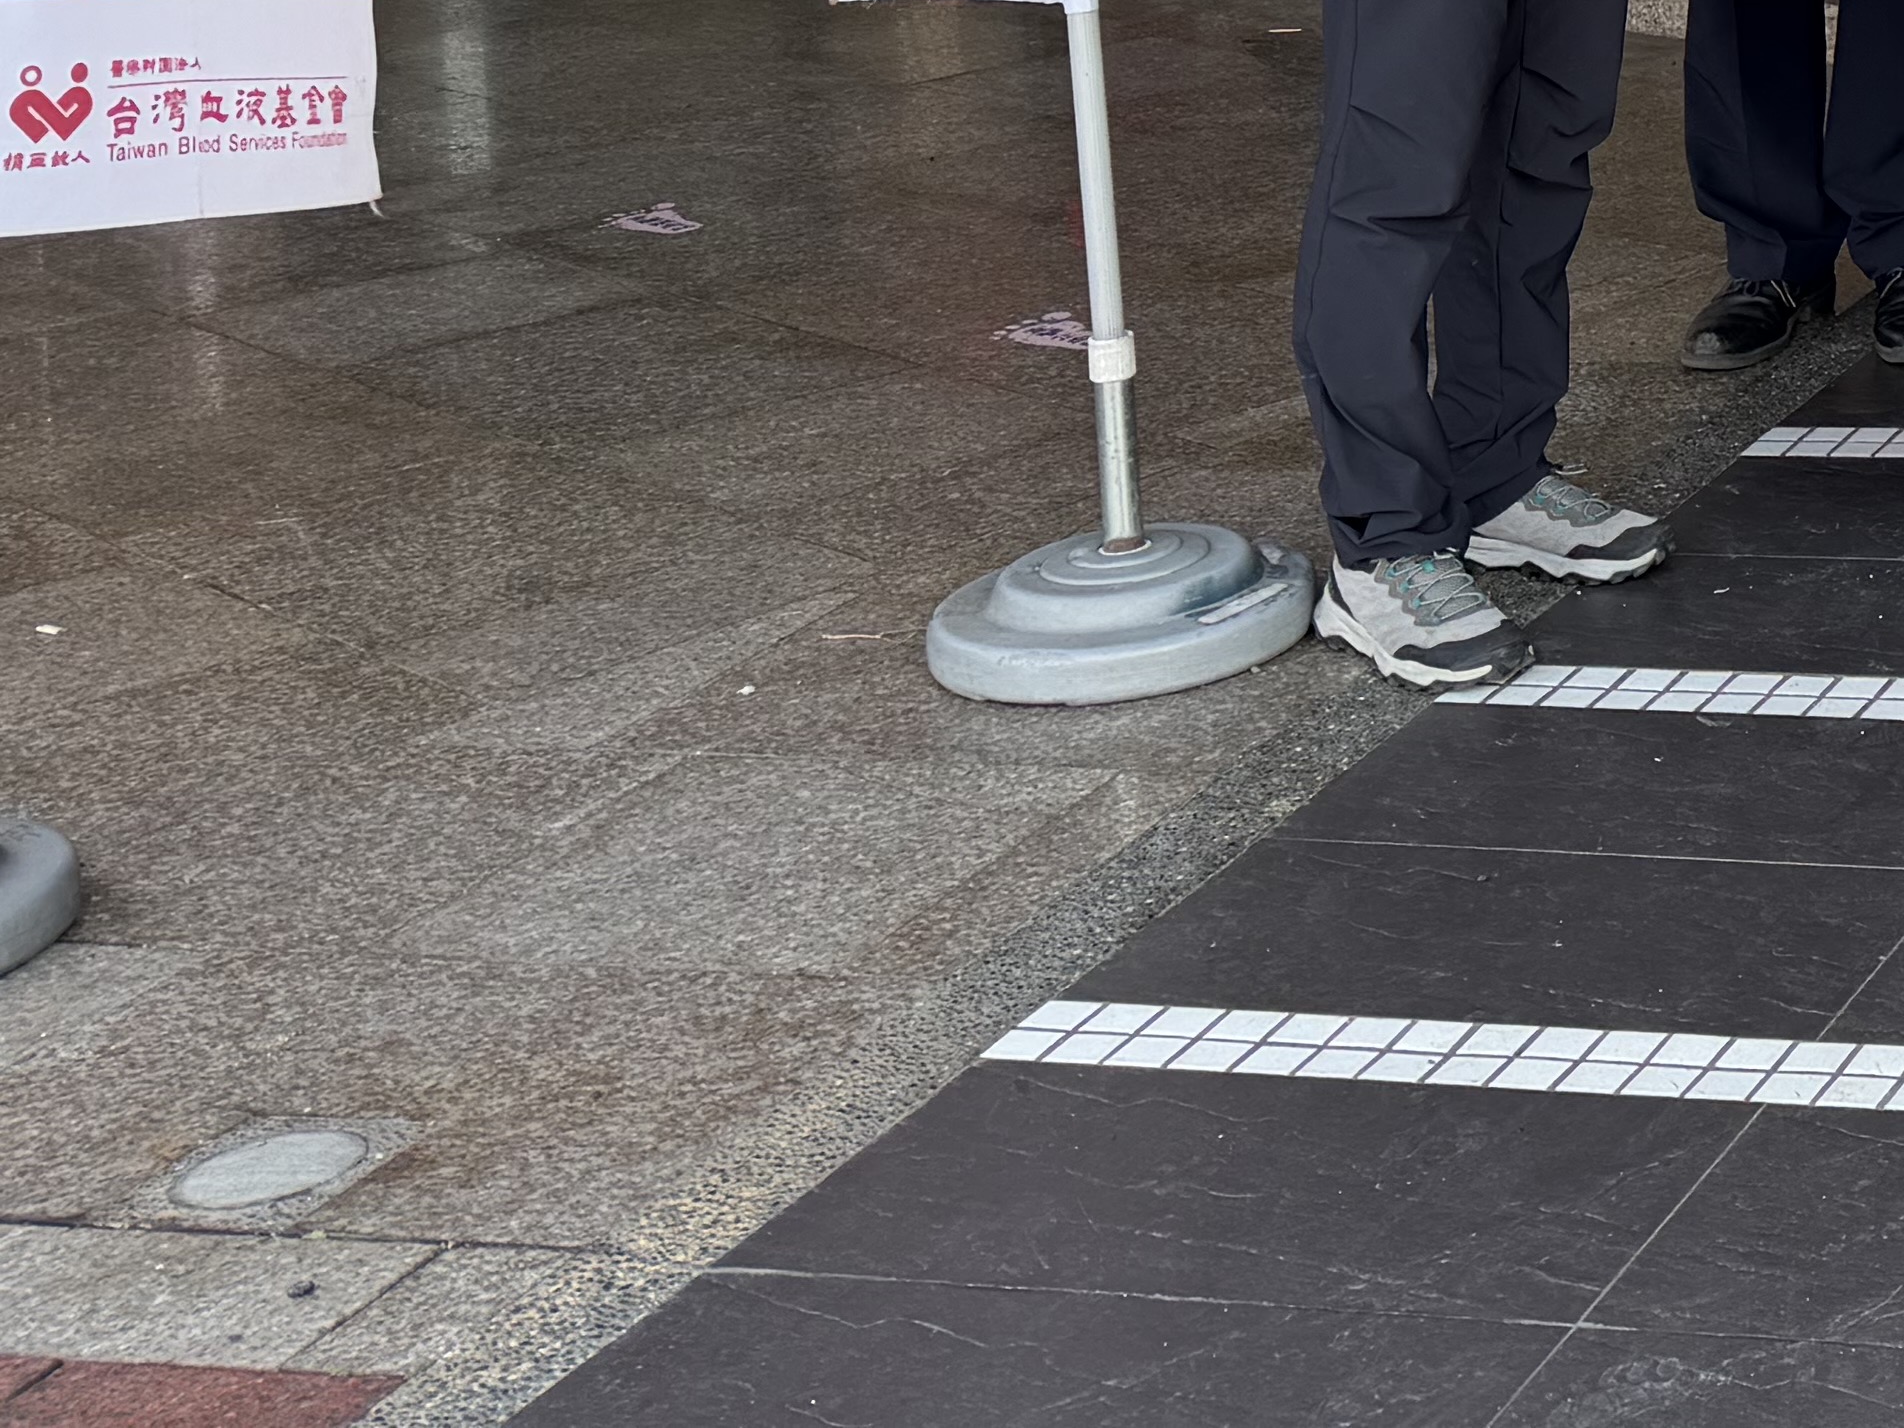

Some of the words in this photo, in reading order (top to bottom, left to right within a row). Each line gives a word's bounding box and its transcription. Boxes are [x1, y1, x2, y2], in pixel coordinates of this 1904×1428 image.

[106, 83, 349, 139] 台灣血液基金會
[106, 142, 169, 162] Taiwan
[229, 131, 288, 152] Services
